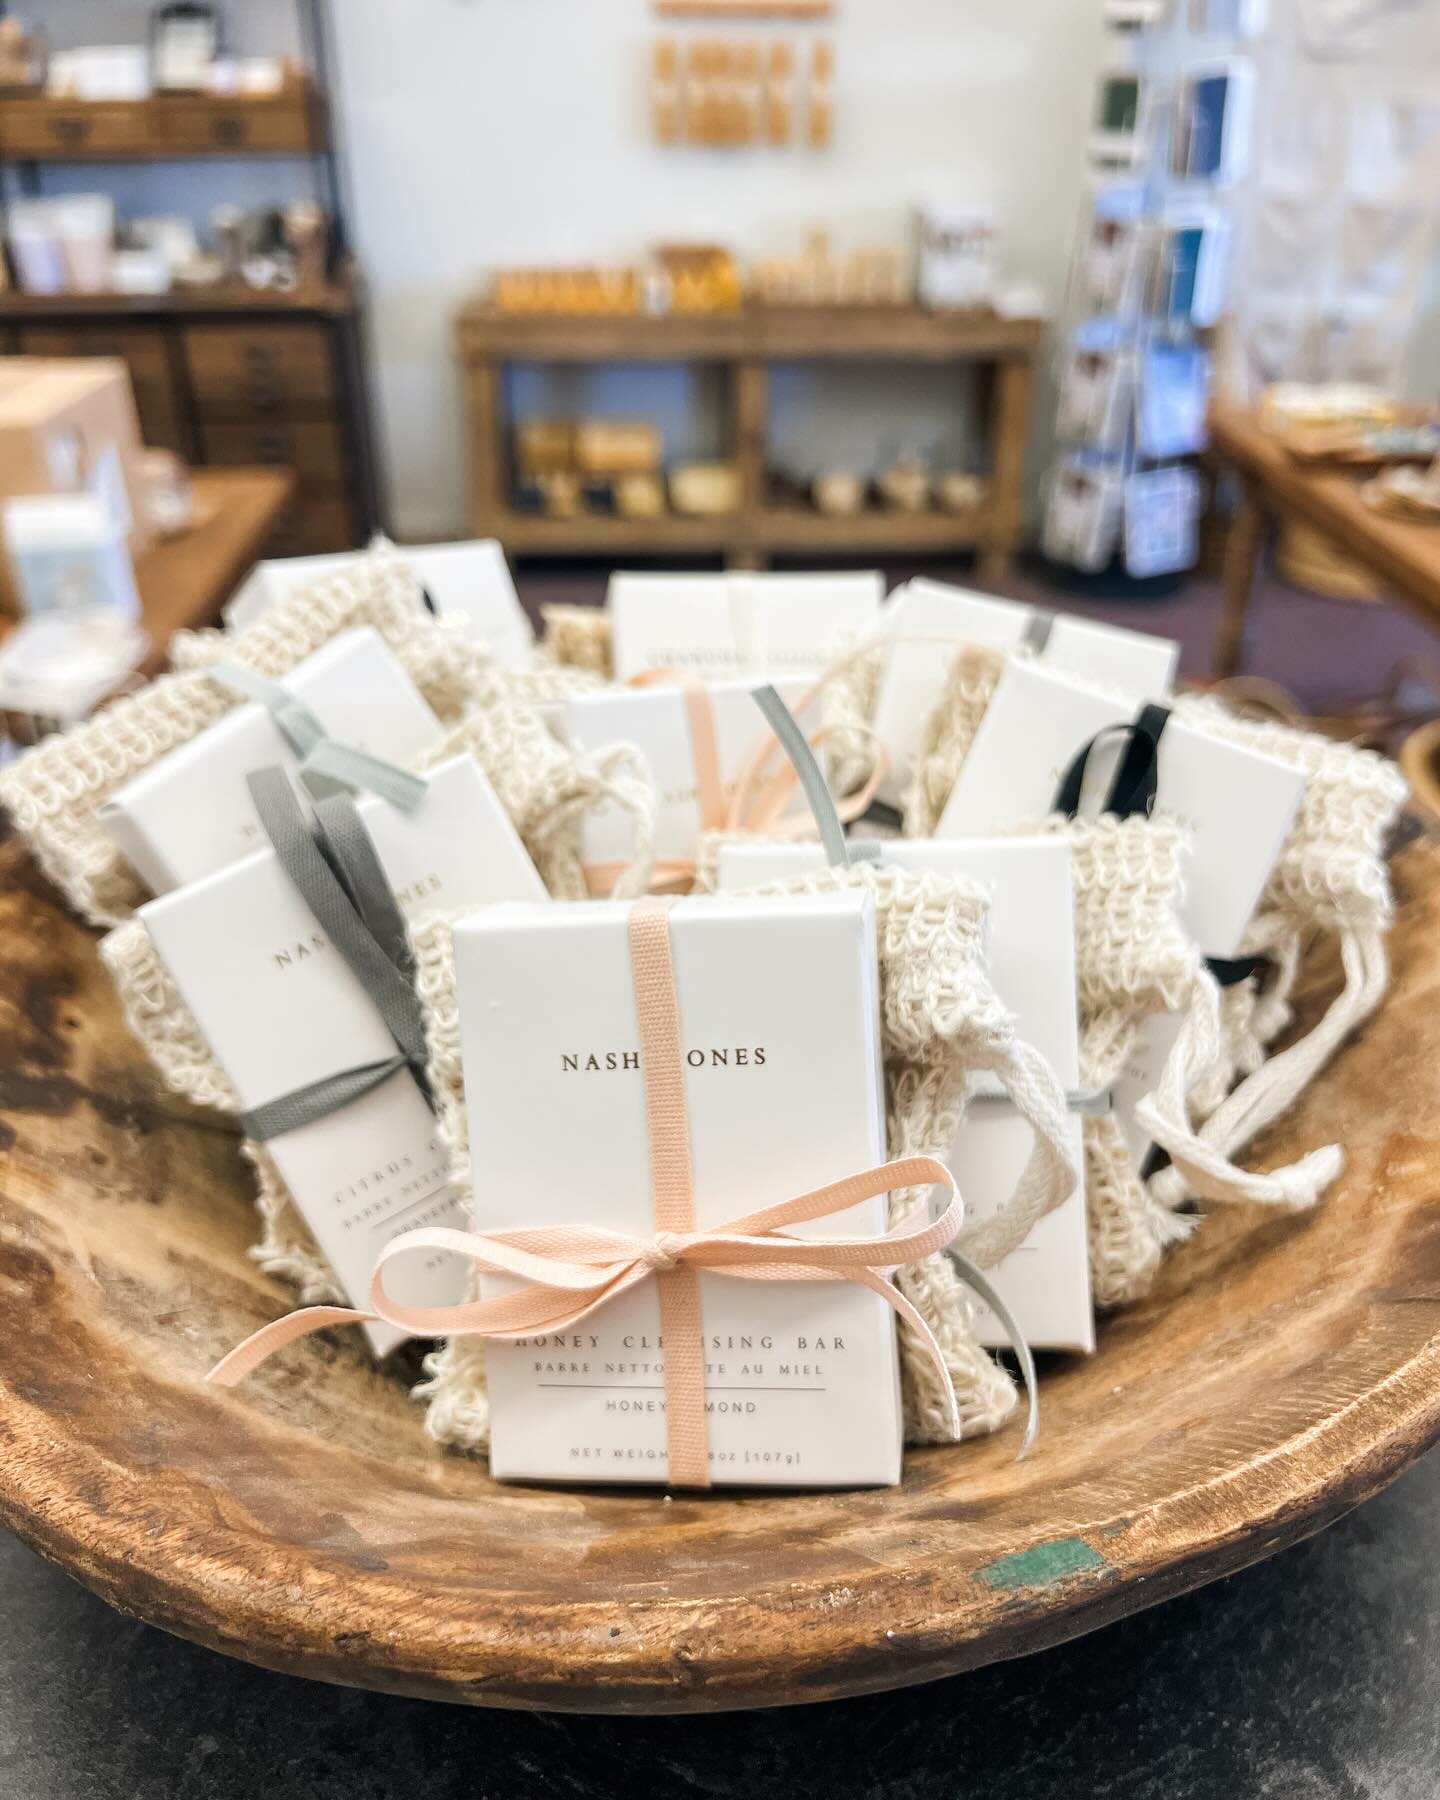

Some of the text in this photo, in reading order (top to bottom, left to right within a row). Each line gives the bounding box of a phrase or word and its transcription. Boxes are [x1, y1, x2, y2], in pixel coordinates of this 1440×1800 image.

[273, 934, 325, 969] NAS
[561, 1047, 767, 1071] NASH ONES
[798, 1337, 846, 1350] BAR
[534, 1362, 824, 1375] BARRE NETTOTE AU MIEL
[606, 1400, 756, 1413] HONEY MOND
[569, 1448, 602, 1457] NET
[612, 1449, 669, 1459] WEIGH
